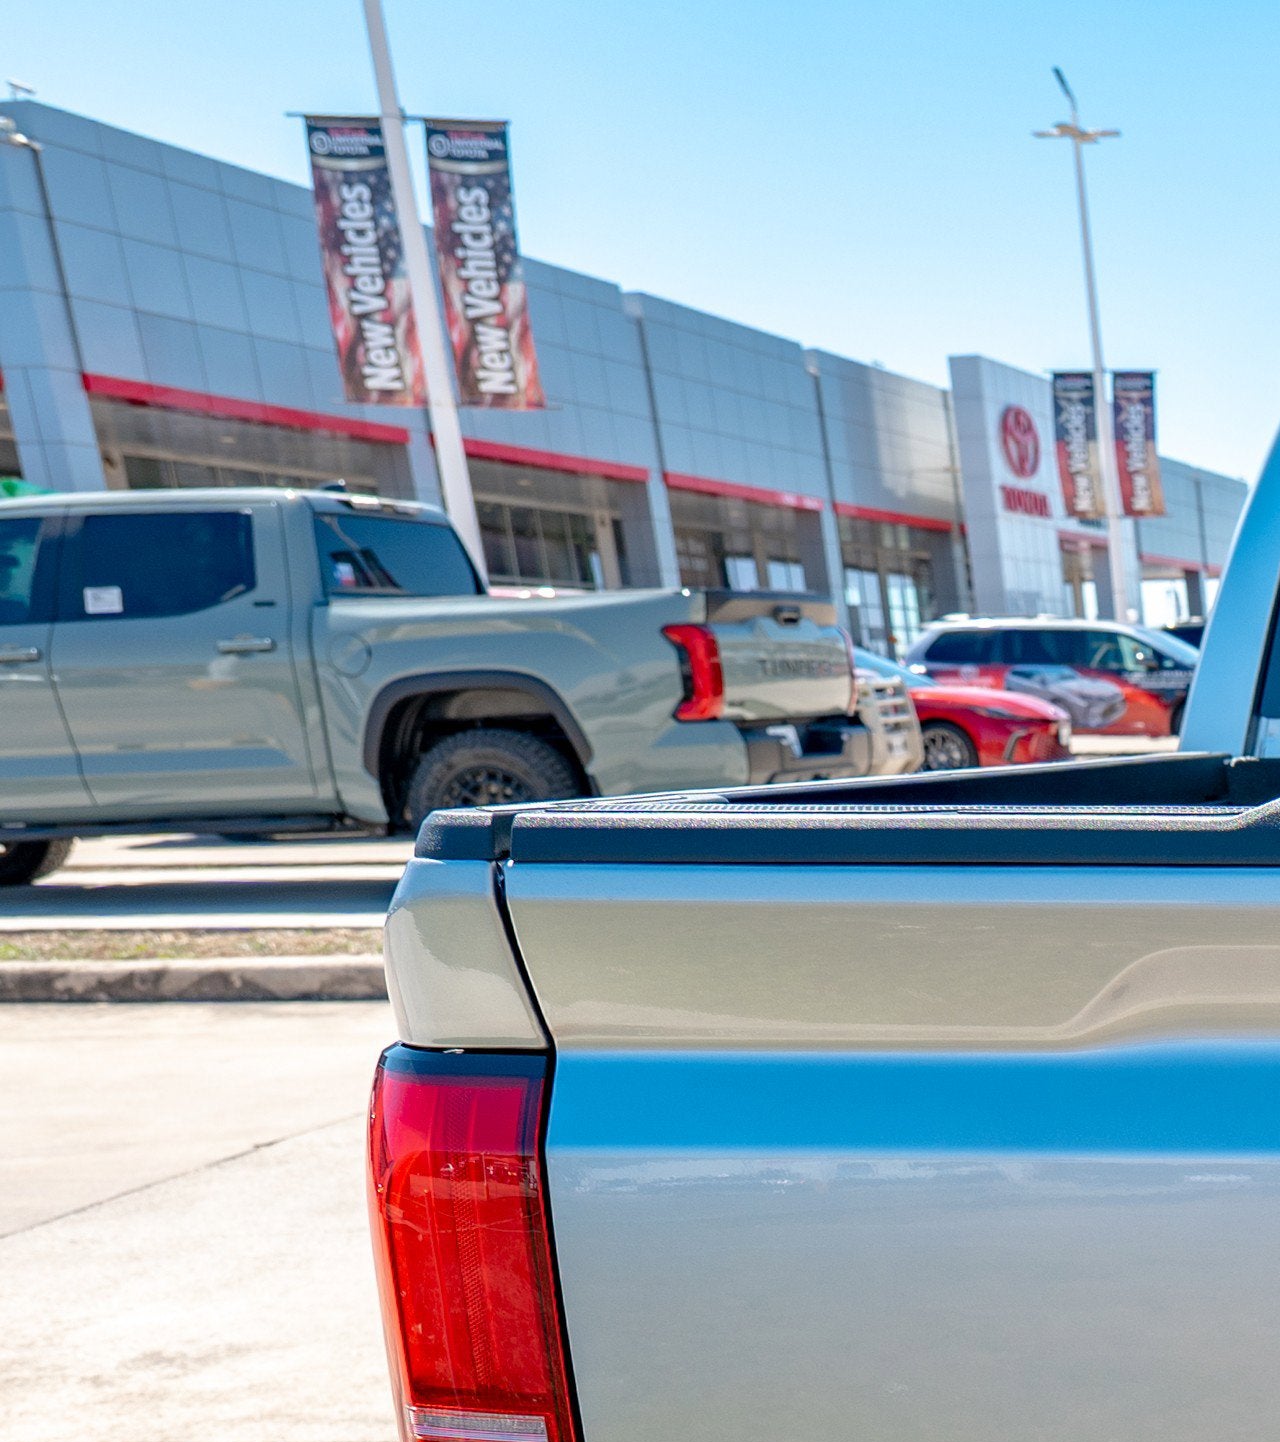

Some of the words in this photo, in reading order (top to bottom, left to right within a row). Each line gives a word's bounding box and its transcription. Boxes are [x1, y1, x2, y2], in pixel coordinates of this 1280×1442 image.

[338, 183, 386, 316] Vehicles
[452, 186, 504, 318] Vehicles
[361, 321, 404, 391] New
[474, 323, 519, 394] New
